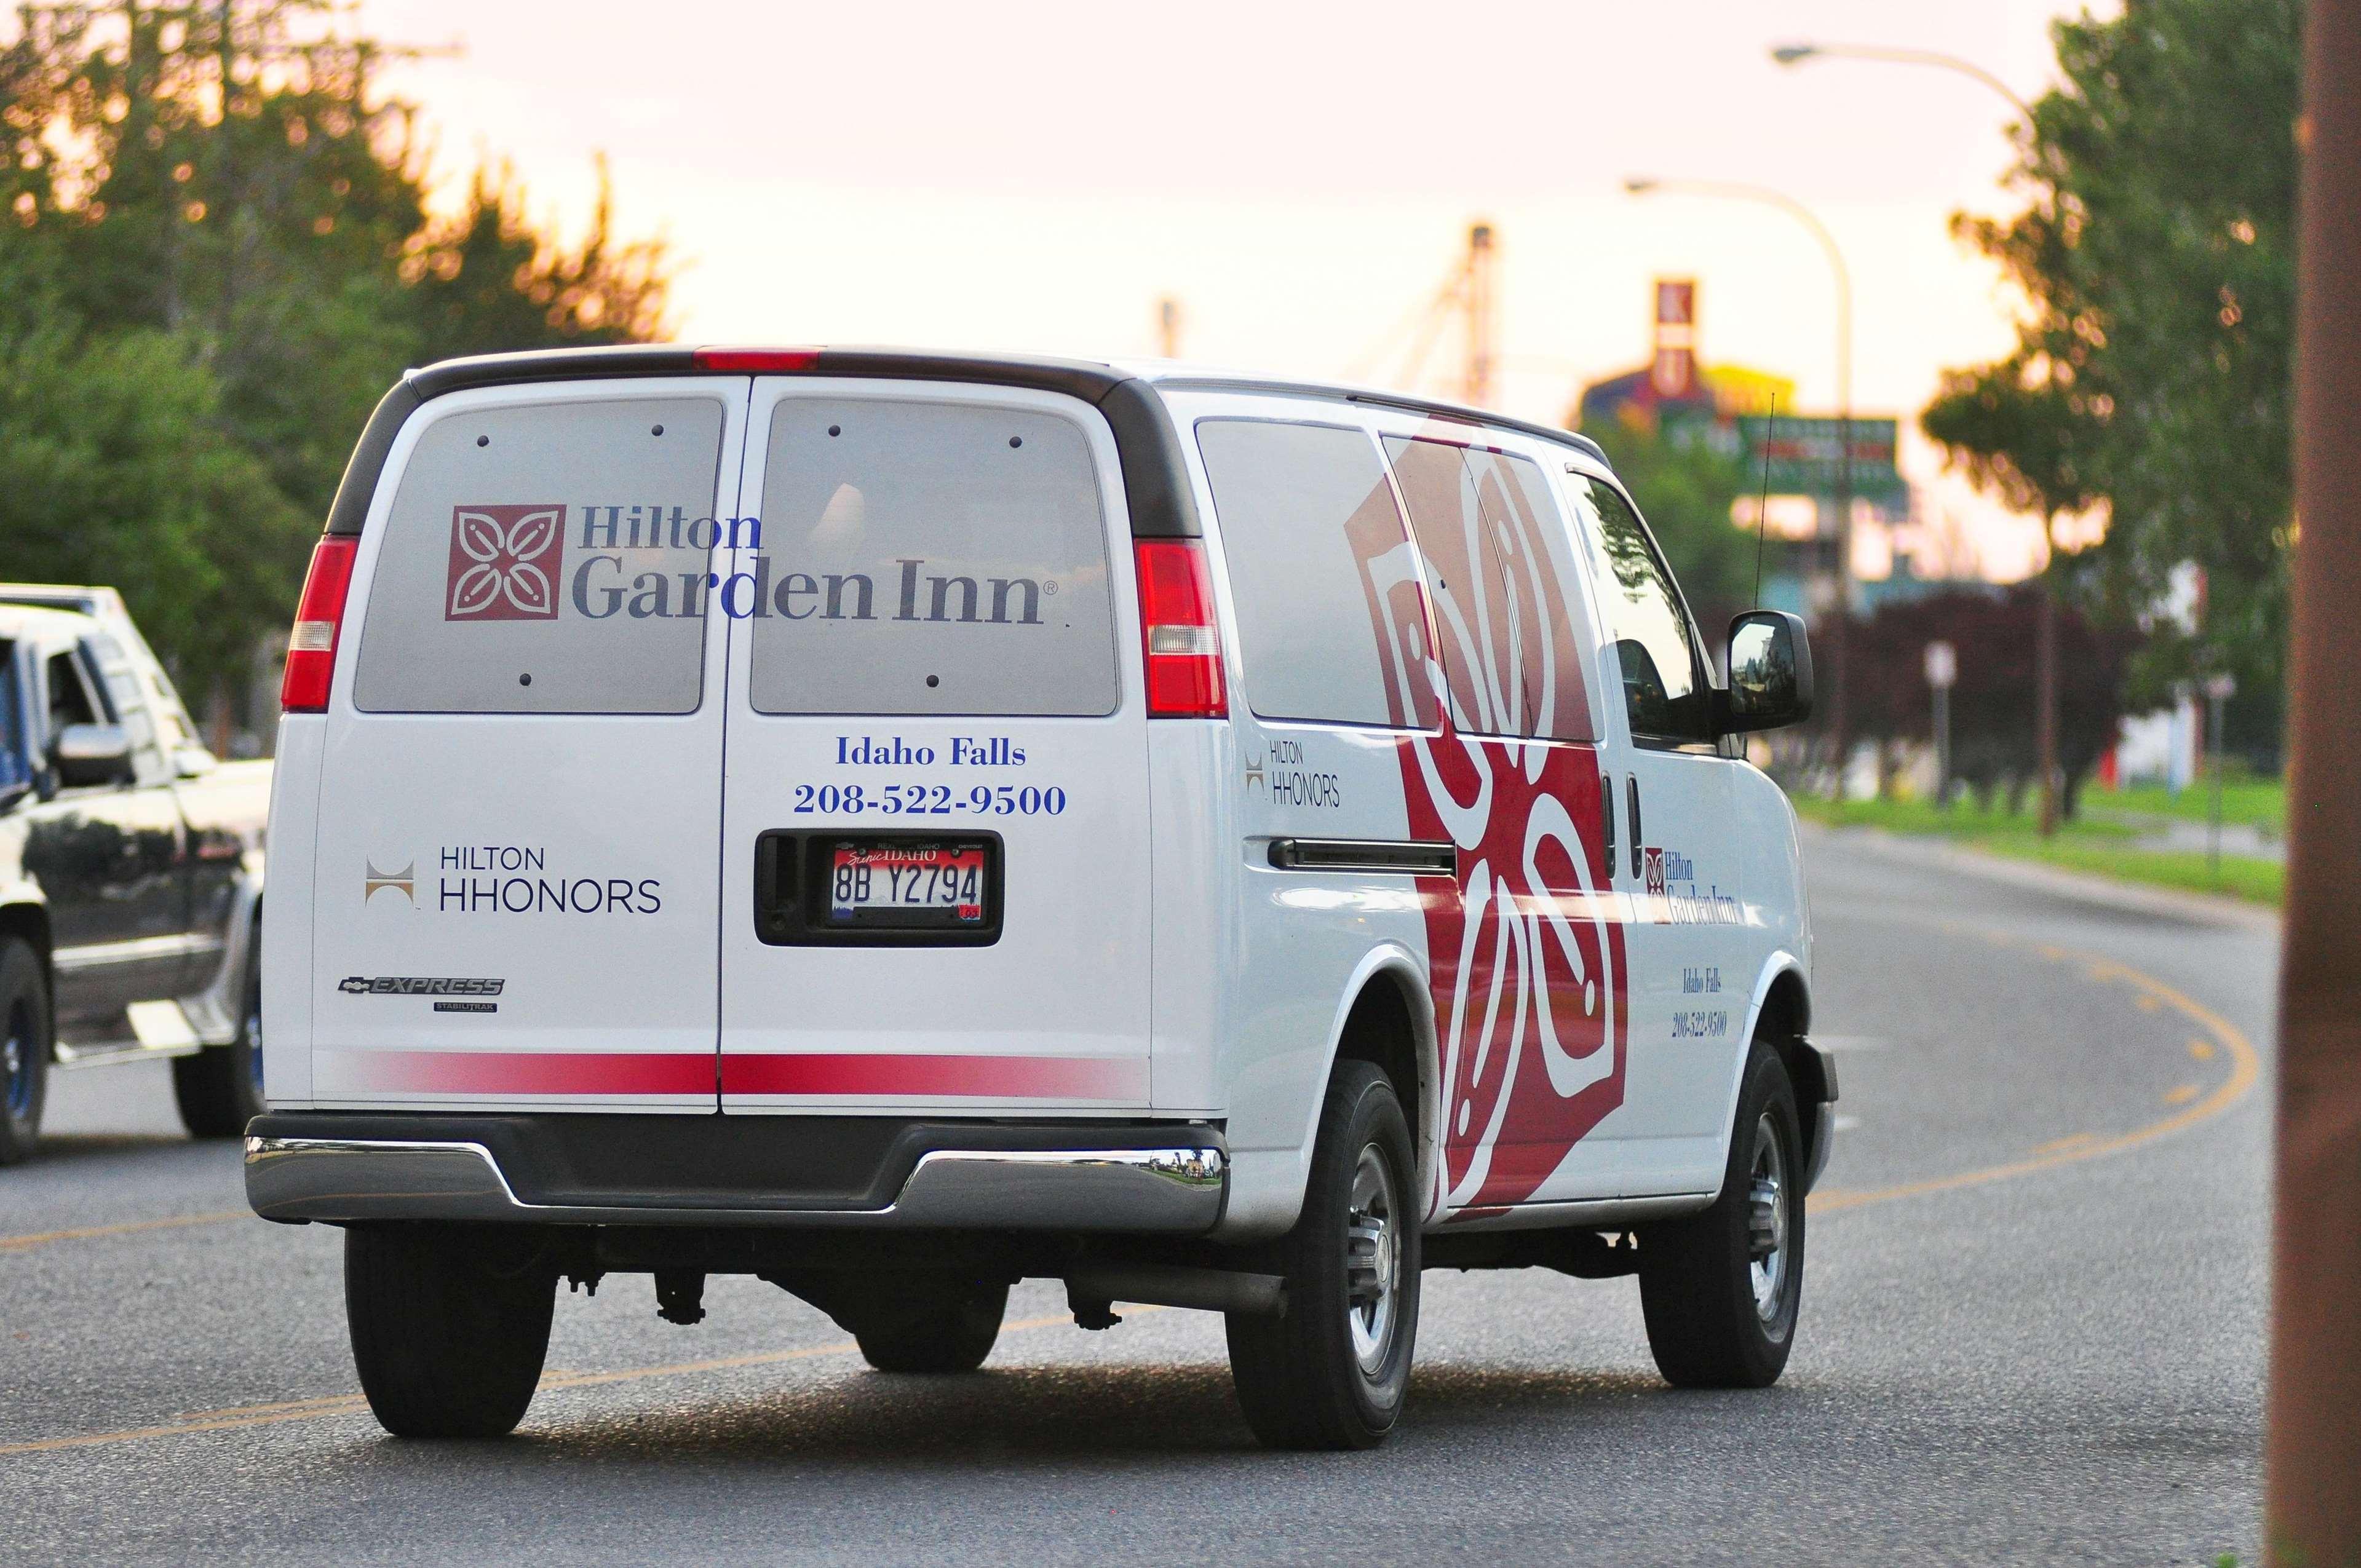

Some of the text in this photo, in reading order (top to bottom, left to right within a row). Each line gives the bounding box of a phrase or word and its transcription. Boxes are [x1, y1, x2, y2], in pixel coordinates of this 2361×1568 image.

[577, 505, 764, 549] Hilton
[571, 555, 878, 620] Garden
[835, 736, 1026, 766] Idaho Falls
[1269, 740, 1304, 764] HILTON
[793, 783, 1066, 815] 208-522-9500
[1272, 770, 1340, 807] HHONORS
[440, 847, 544, 871] HILTON
[884, 850, 937, 861] IDAHO
[1664, 852, 1693, 880] Hilton
[440, 877, 661, 914] HHONORS
[835, 863, 978, 903] 8B Y2794
[1667, 884, 1739, 925] Garden Inn
[370, 977, 505, 995] EXPRESS
[1683, 967, 1721, 994] Idaho Falls
[436, 1002, 494, 1011] STABILITRAK
[1672, 1011, 1727, 1037] 208-522-9500
